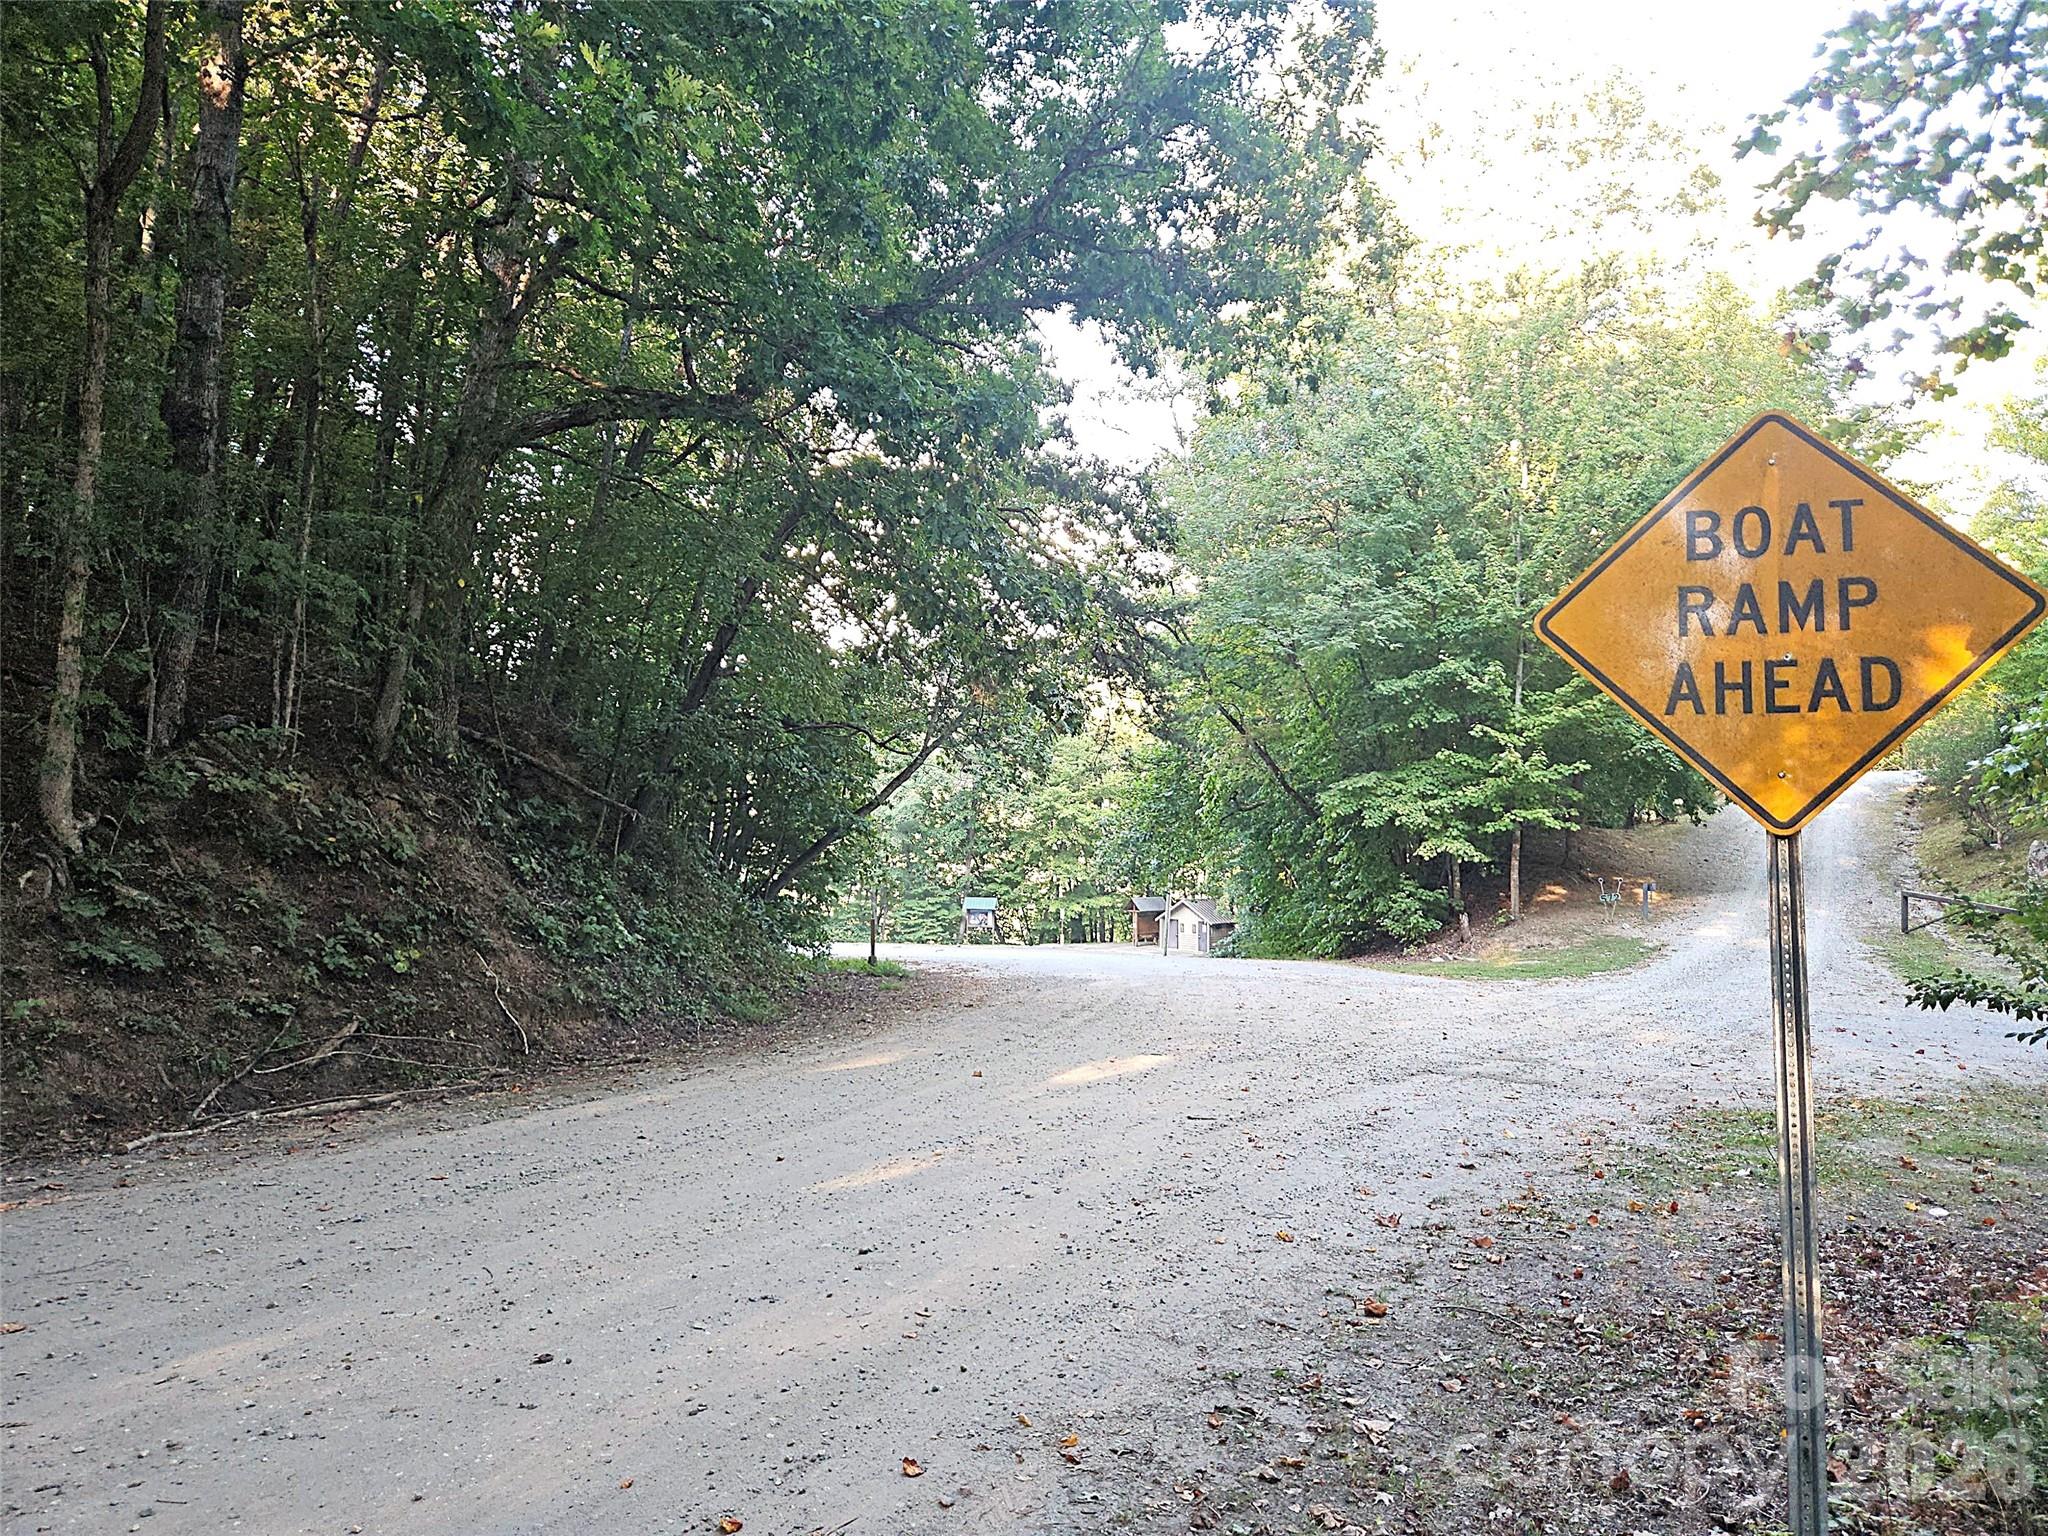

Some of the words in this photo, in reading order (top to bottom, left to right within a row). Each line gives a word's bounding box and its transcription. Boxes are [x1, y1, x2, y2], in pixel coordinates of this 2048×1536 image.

[1685, 499, 1865, 562] BOAT
[1677, 576, 1878, 638] RAMP
[1664, 655, 1902, 716] AHEAD
